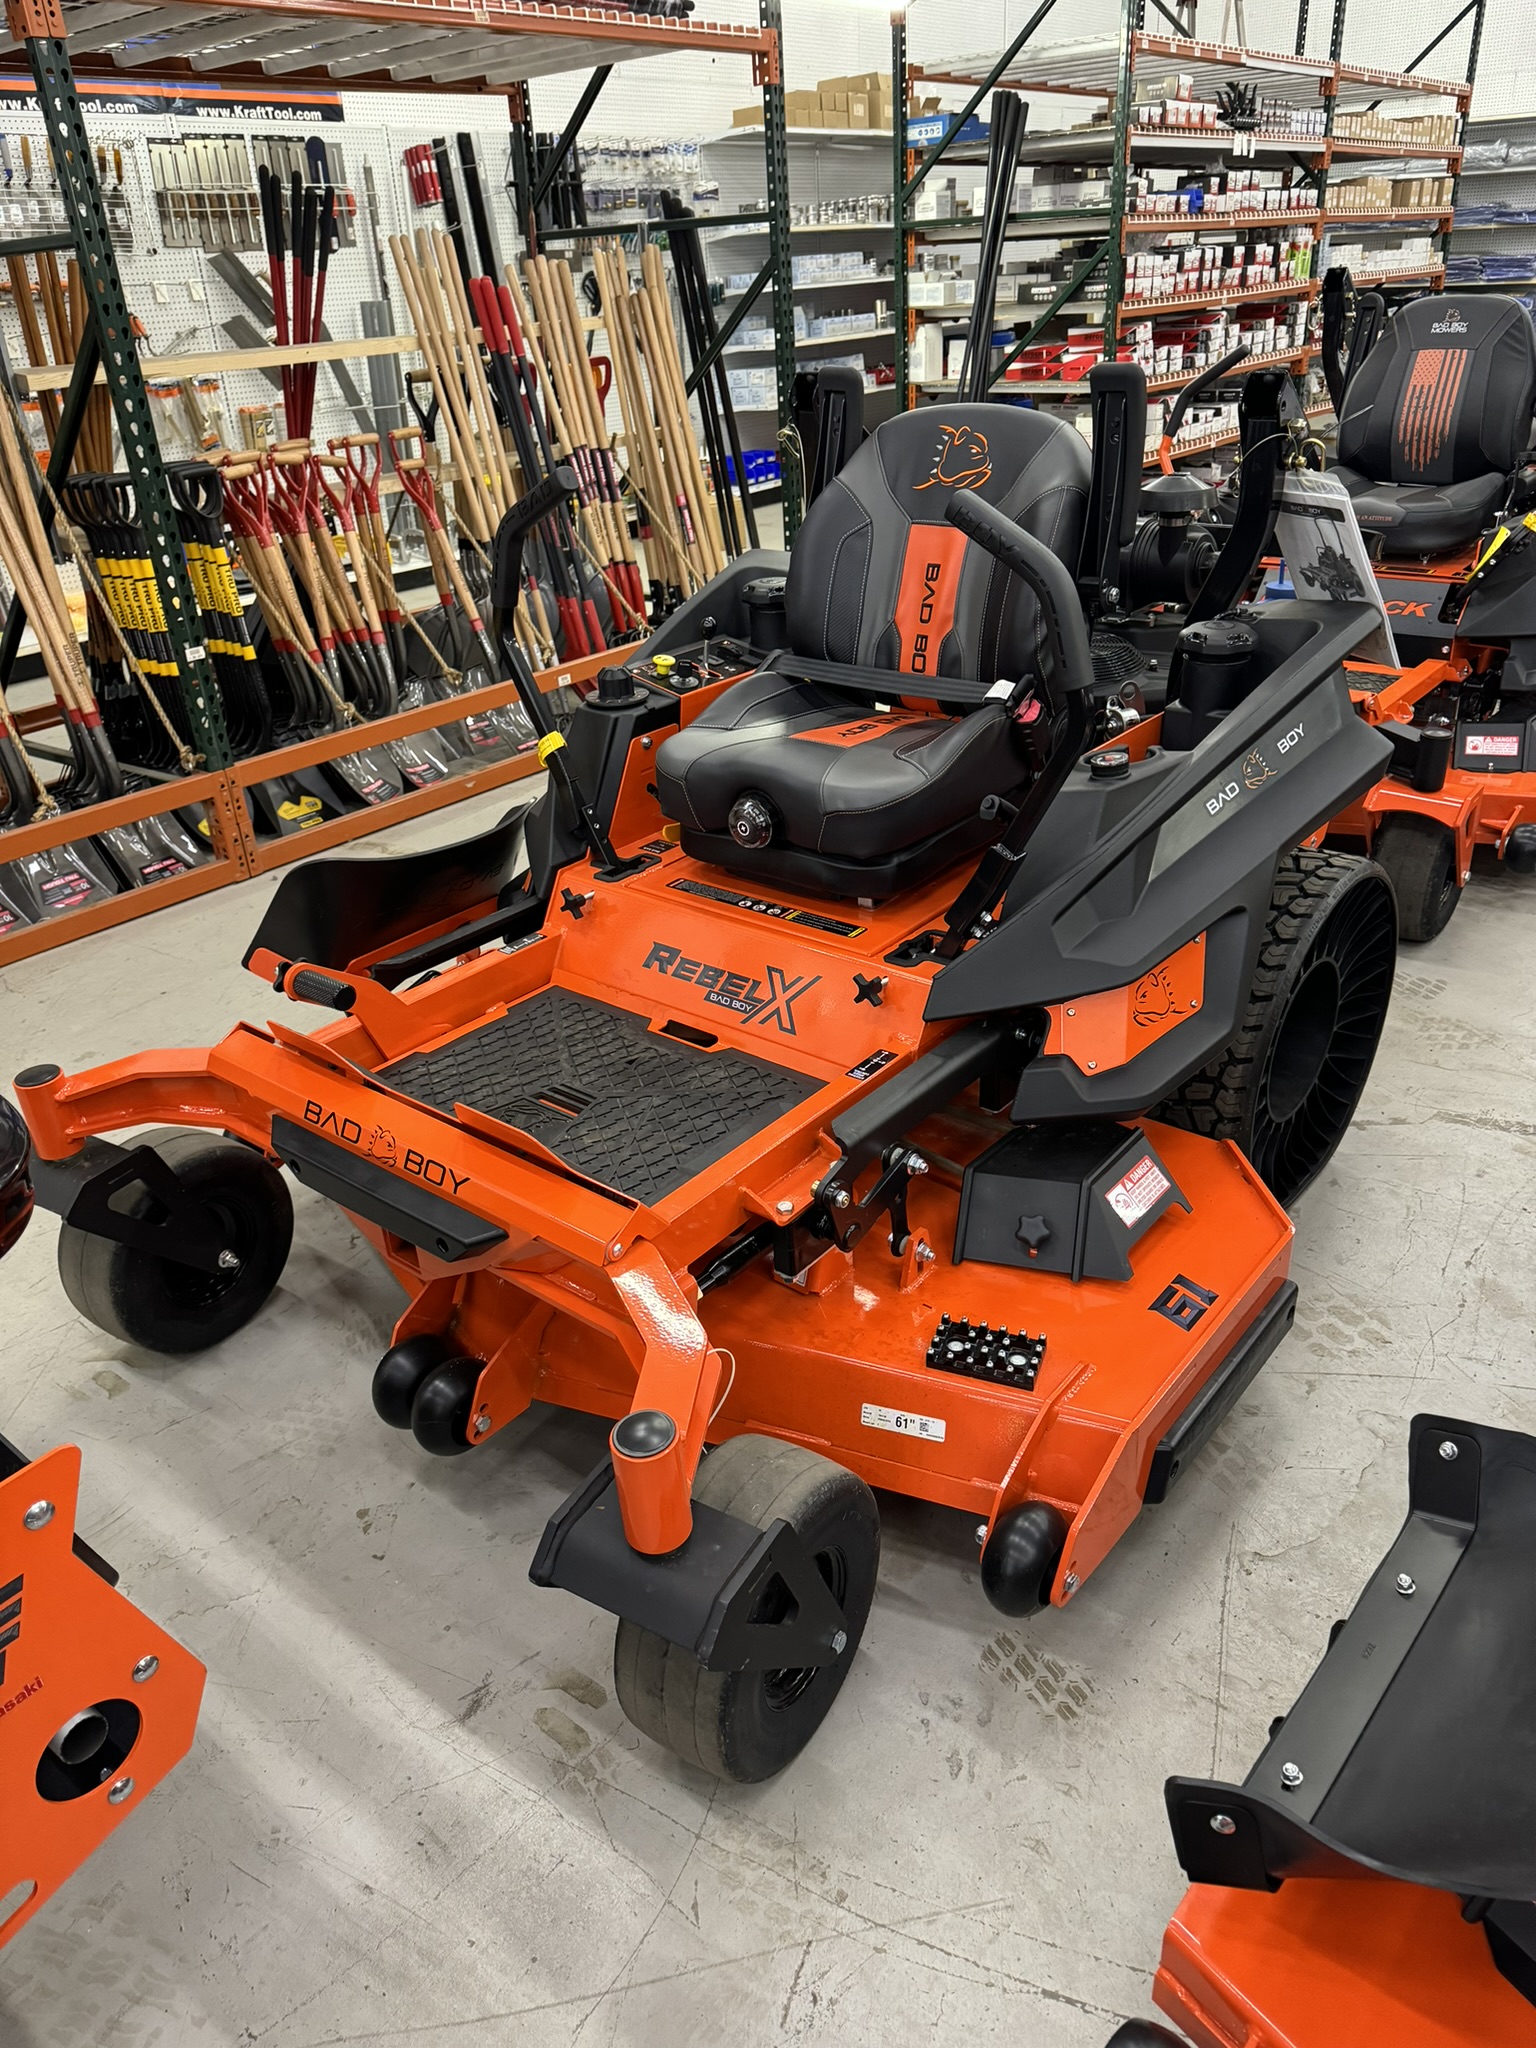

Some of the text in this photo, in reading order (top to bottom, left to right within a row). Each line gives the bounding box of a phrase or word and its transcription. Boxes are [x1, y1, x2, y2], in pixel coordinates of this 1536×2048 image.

[196, 105, 322, 121] www.KraftTool.com
[954, 505, 1021, 556] BOY
[206, 585, 216, 608] PRO
[224, 569, 243, 614] TRU PRO
[1383, 599, 1433, 617] CK
[911, 563, 941, 673] BAD BO
[62, 644, 80, 678] TRUPER
[69, 632, 83, 666] TRUPER
[838, 723, 878, 739] BOY
[1206, 722, 1304, 815] BAD BOY
[709, 992, 753, 1013] BAD BOY
[303, 1099, 471, 1195] BAD BOY
[1129, 1159, 1153, 1183] DANGER
[1147, 1273, 1219, 1332] 61
[895, 1416, 916, 1429] 61"
[0, 1676, 43, 1718] asaki
